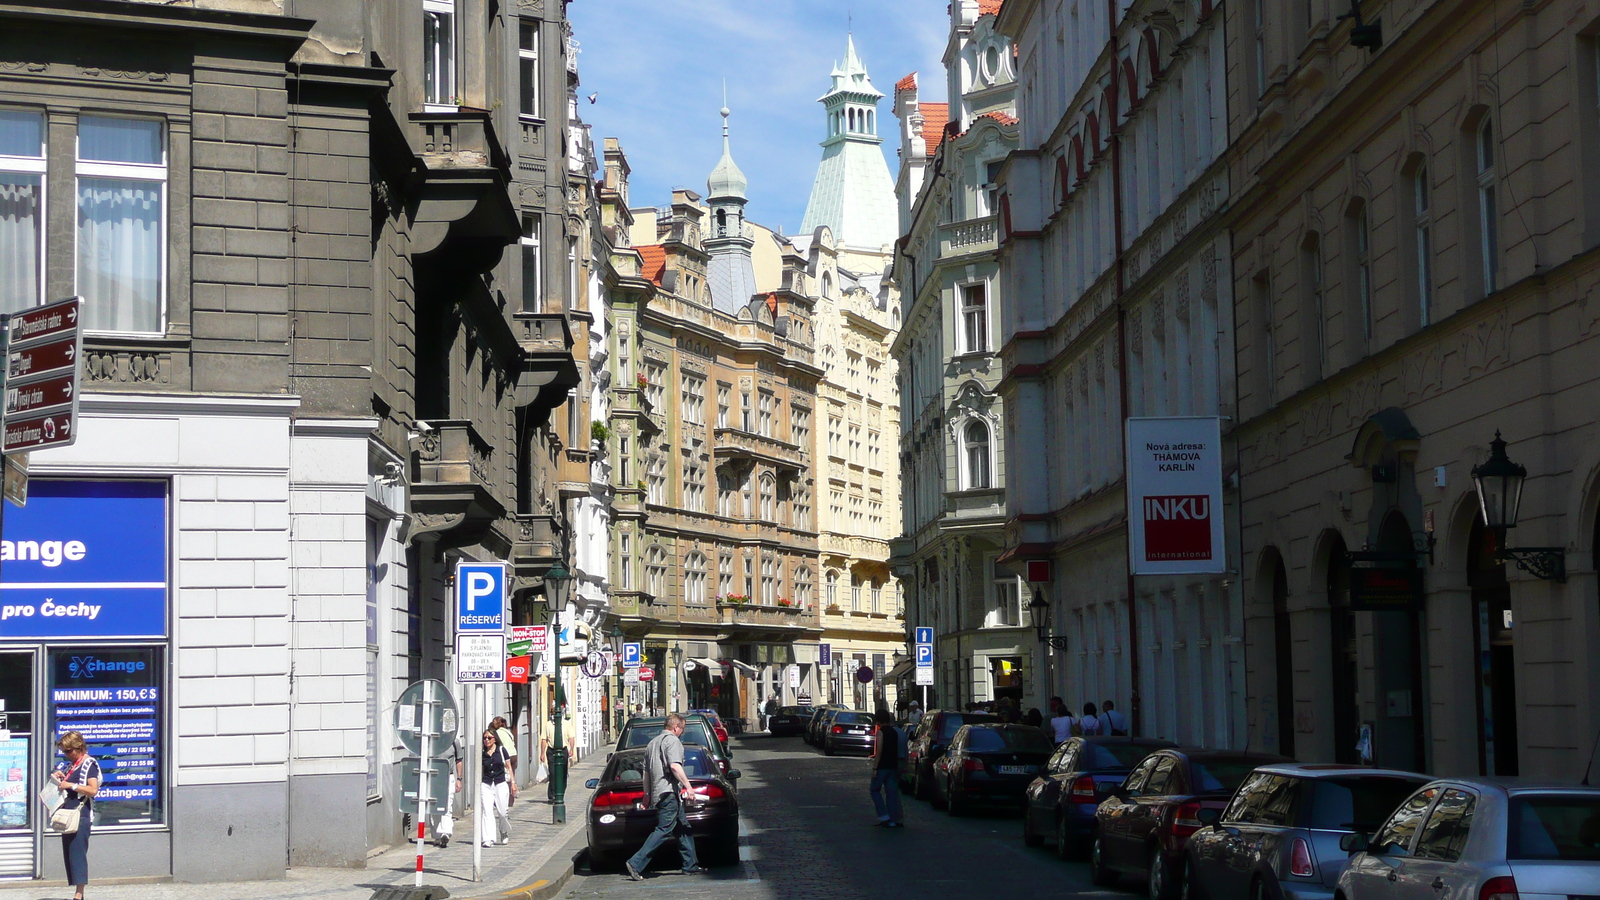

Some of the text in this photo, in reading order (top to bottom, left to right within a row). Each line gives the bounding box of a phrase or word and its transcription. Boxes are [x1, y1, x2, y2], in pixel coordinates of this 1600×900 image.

[1146, 442, 1206, 451] Nová adresa:
[1153, 452, 1201, 462] THÁMOVA
[1158, 461, 1195, 472] KARLÍN
[1145, 497, 1209, 521] INKU
[467, 572, 495, 610] P
[2, 598, 101, 620] pro Čechy
[460, 614, 501, 624] RÉSERVÉ
[626, 645, 637, 660] P
[920, 647, 930, 661] P
[69, 656, 146, 678] eXchange
[461, 671, 488, 679] OBLAST
[54, 690, 113, 701] MINIMUM:
